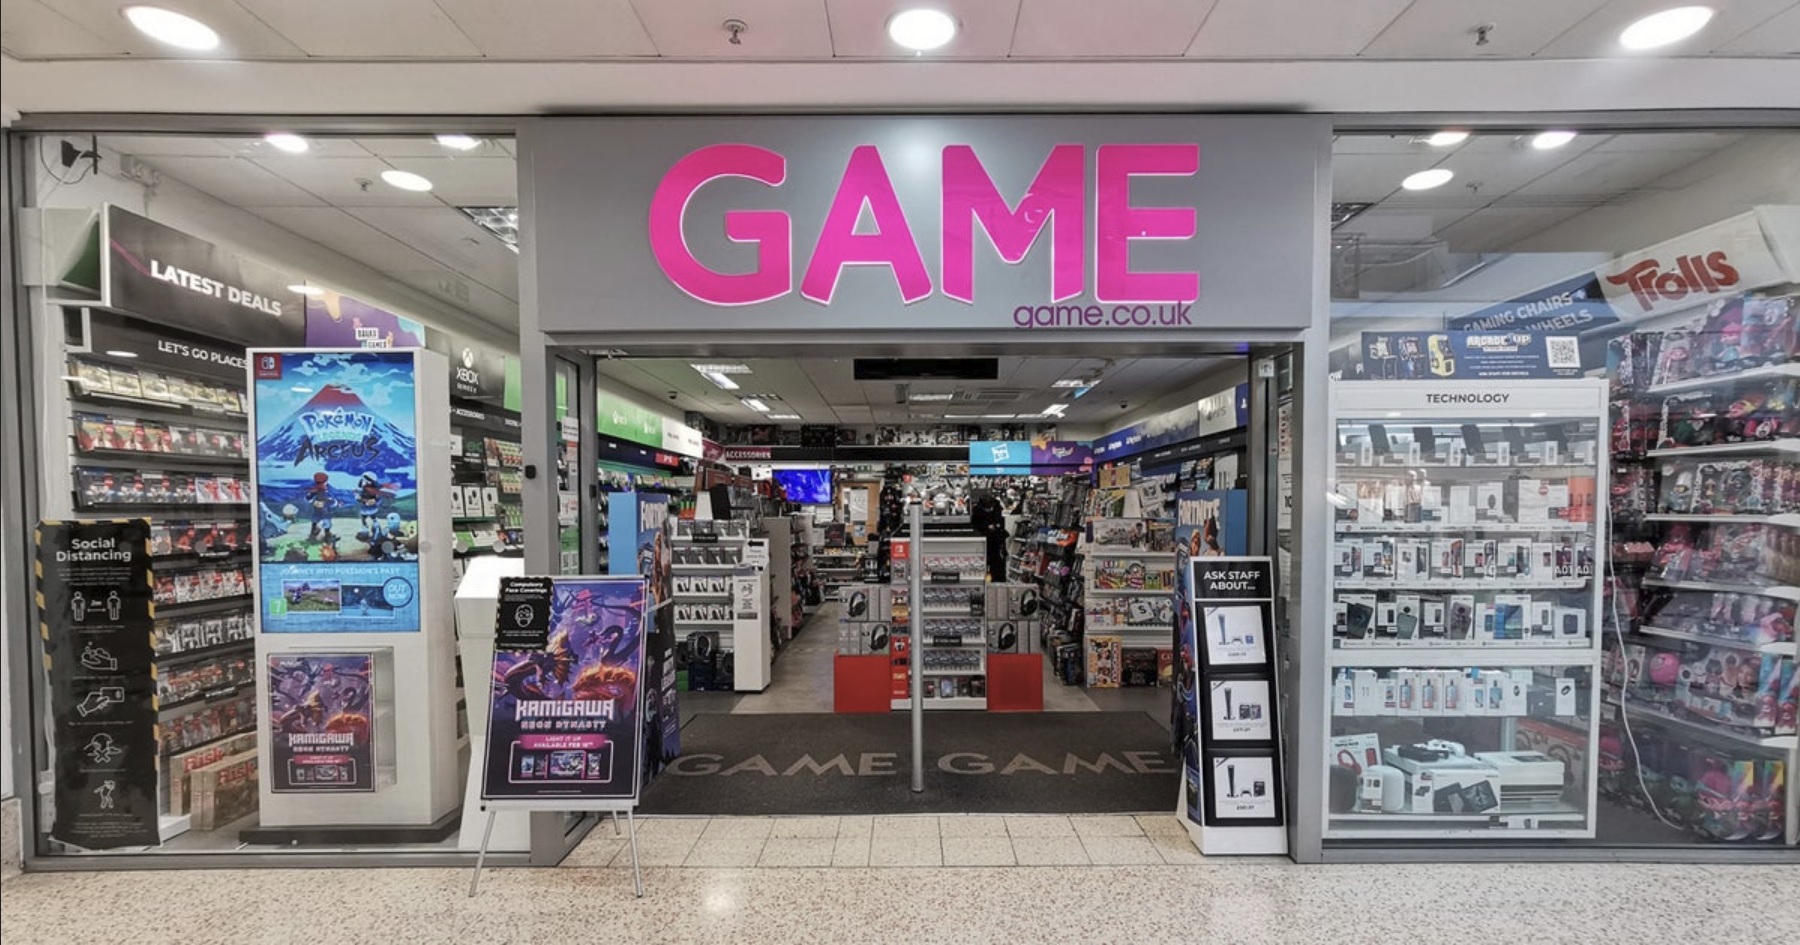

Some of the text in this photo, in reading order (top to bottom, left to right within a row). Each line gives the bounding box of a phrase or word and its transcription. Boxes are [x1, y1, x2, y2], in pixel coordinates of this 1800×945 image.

[649, 143, 1200, 305] GAME
[150, 259, 282, 317] LATEST DEALS
[1606, 252, 1740, 311] Trolls
[1013, 301, 1193, 329] game.co.uk
[1463, 292, 1573, 332] GAMING CHAIRS
[158, 340, 248, 370] LET'S GO PLACES
[456, 366, 479, 385] XBOX
[1426, 393, 1509, 403] TECHNOLOGY
[294, 436, 380, 467] ARCEUS
[726, 450, 772, 459] ACCESSORIES
[71, 537, 116, 550] Social
[55, 550, 132, 562] Distancing
[1203, 571, 1260, 580] ASK STAFF
[515, 699, 615, 721] KAMIGAWA
[520, 720, 607, 729] NEON DYNASTY
[668, 751, 1179, 776] GAME GAME
